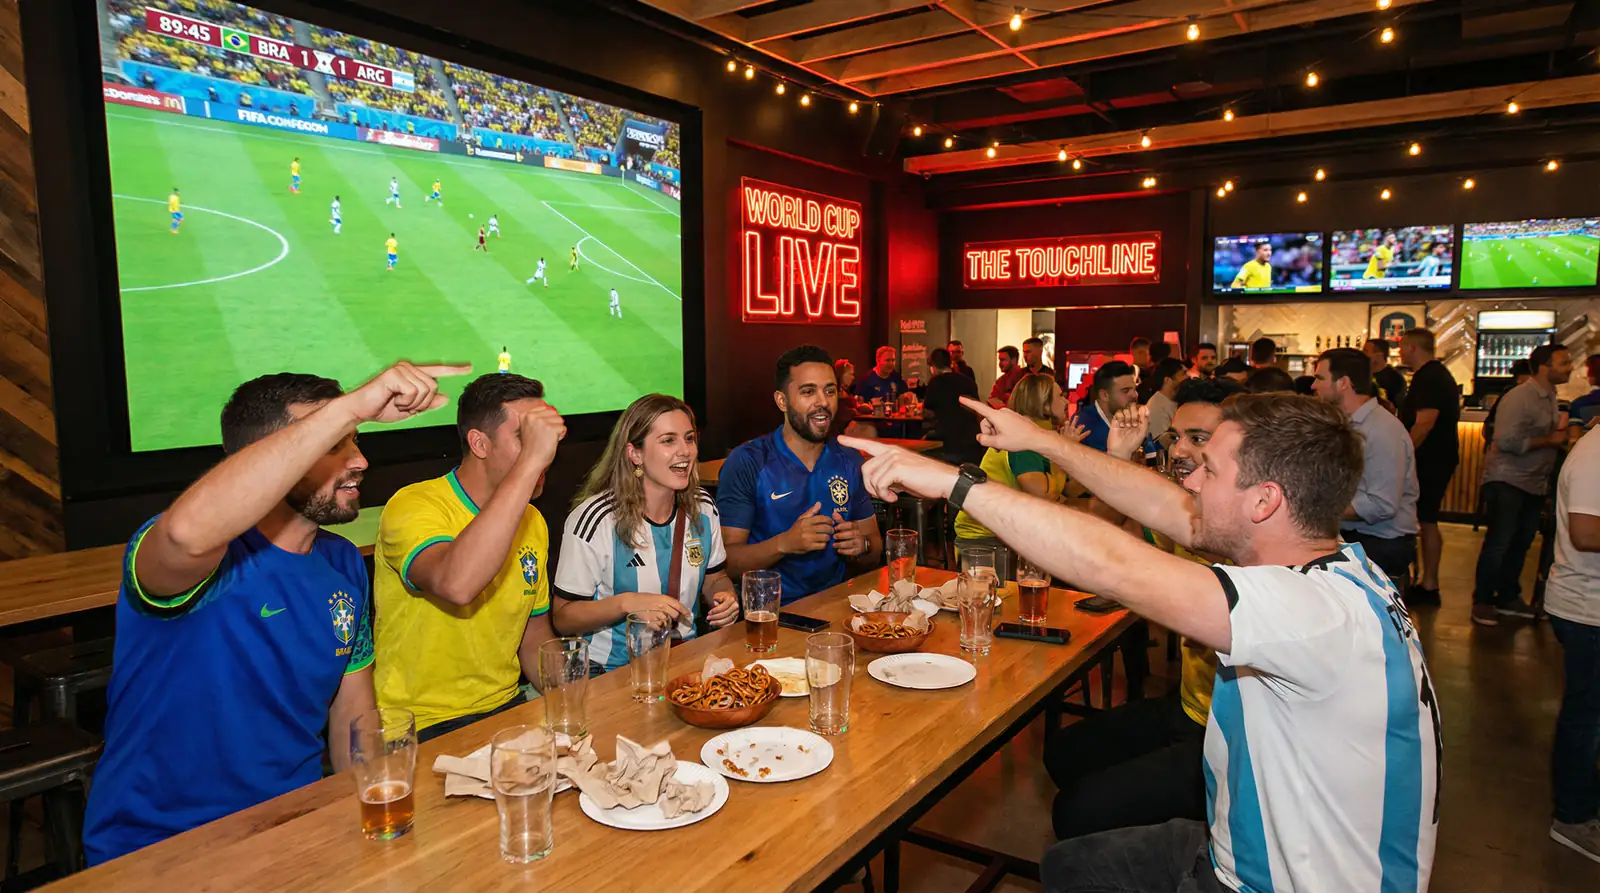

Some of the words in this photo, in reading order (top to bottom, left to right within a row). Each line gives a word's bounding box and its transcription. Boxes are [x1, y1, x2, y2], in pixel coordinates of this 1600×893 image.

[160, 16, 211, 41] 89:45
[257, 40, 290, 60] BRA
[301, 50, 309, 66] 1
[338, 60, 346, 75] 1
[357, 68, 385, 83] ARG
[745, 187, 821, 232] WORLD
[824, 204, 860, 238] CUP
[746, 231, 860, 317] LIVE
[967, 250, 1011, 280] THE
[1016, 242, 1156, 278] TOUCHLINE
